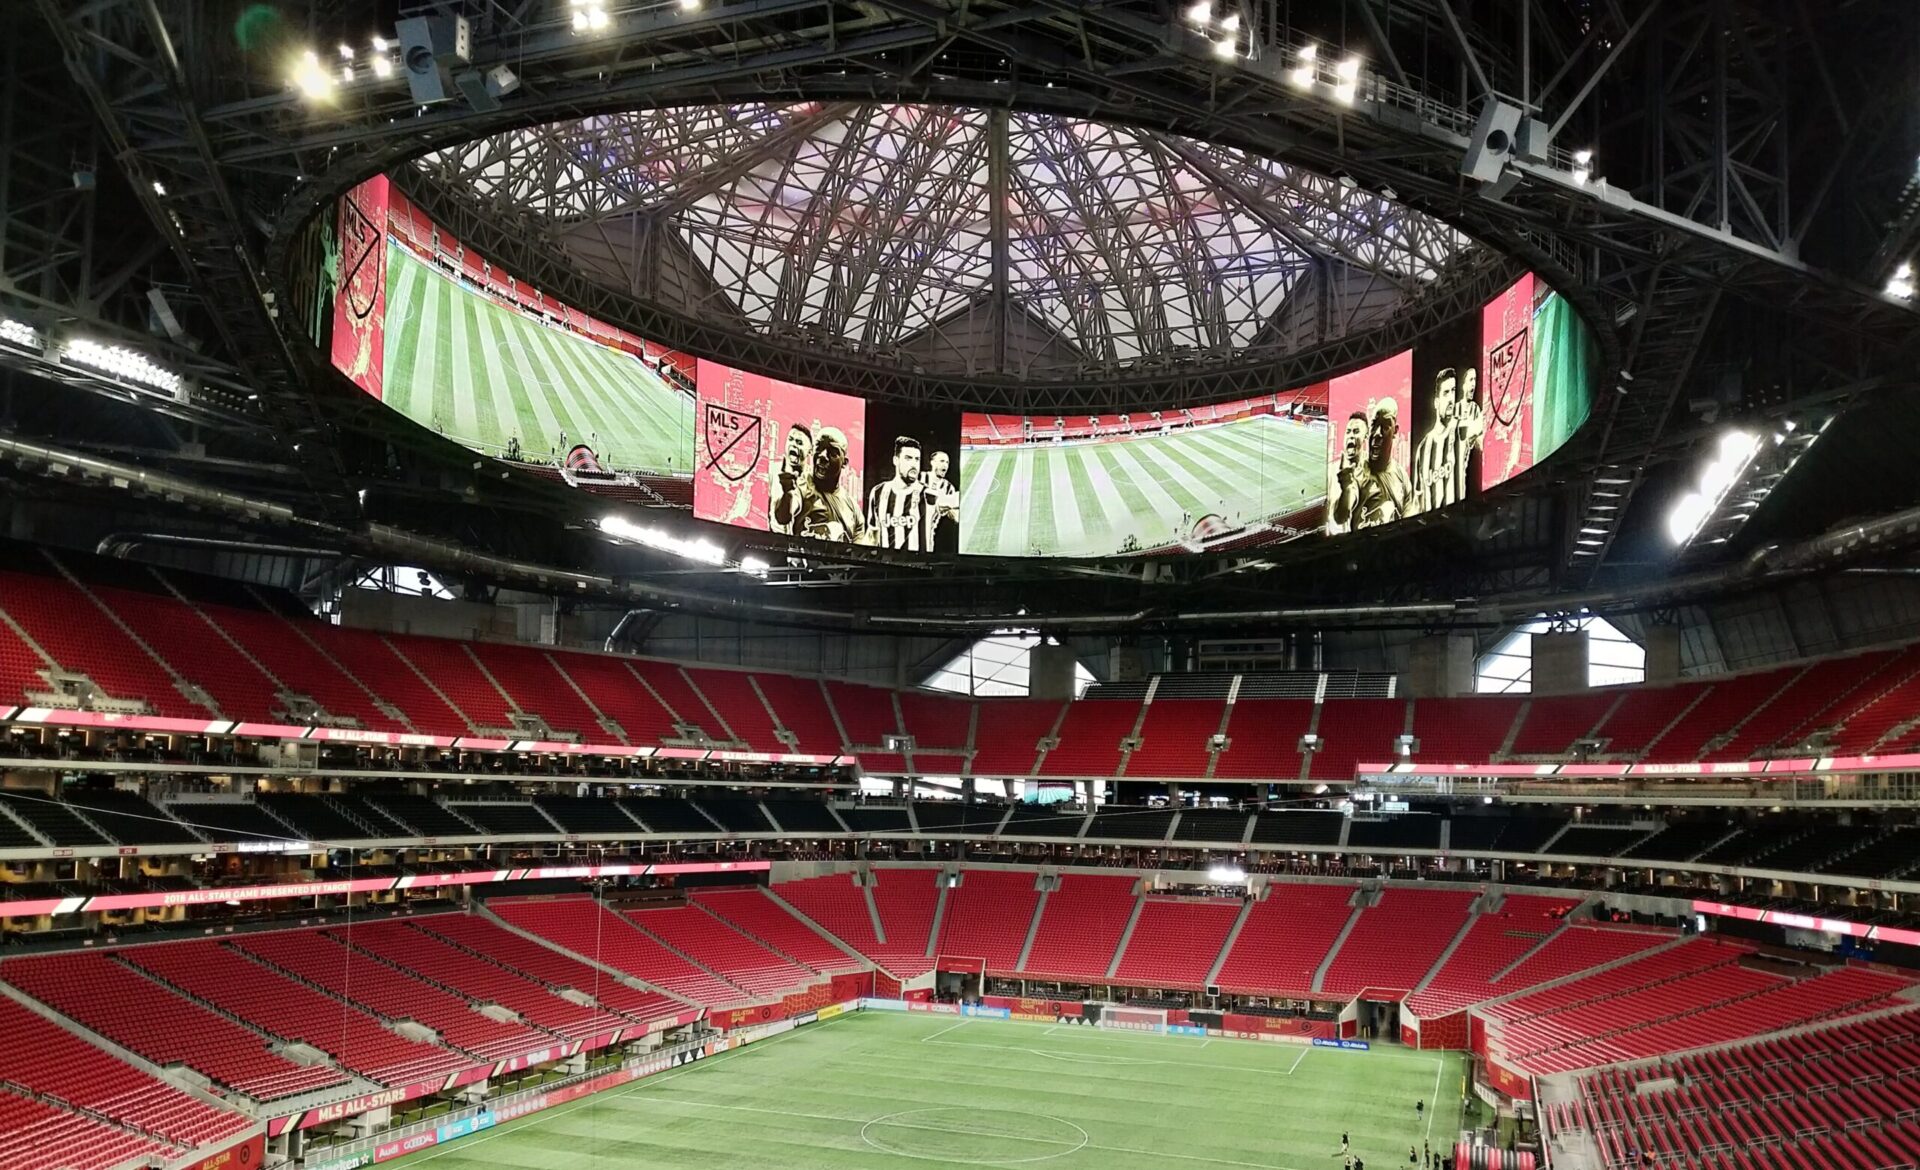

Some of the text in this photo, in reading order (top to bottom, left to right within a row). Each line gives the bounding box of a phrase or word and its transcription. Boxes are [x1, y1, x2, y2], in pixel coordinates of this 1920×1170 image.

[347, 204, 366, 244] MLS
[1492, 347, 1514, 370] MLS
[709, 409, 740, 431] MLS
[1425, 462, 1453, 488] Jeep
[882, 513, 917, 529] Jeep
[188, 891, 231, 902] ALL-STAR
[233, 889, 258, 899] GAME
[261, 886, 308, 897] PRESENTED
[310, 885, 322, 894] BY
[322, 883, 352, 893] TARGET
[648, 1016, 678, 1033] JUVENTUS
[318, 1088, 406, 1122] MLS ALL-STARS
[202, 1152, 230, 1170] ALL-STAR
[378, 1145, 398, 1158] Audi
